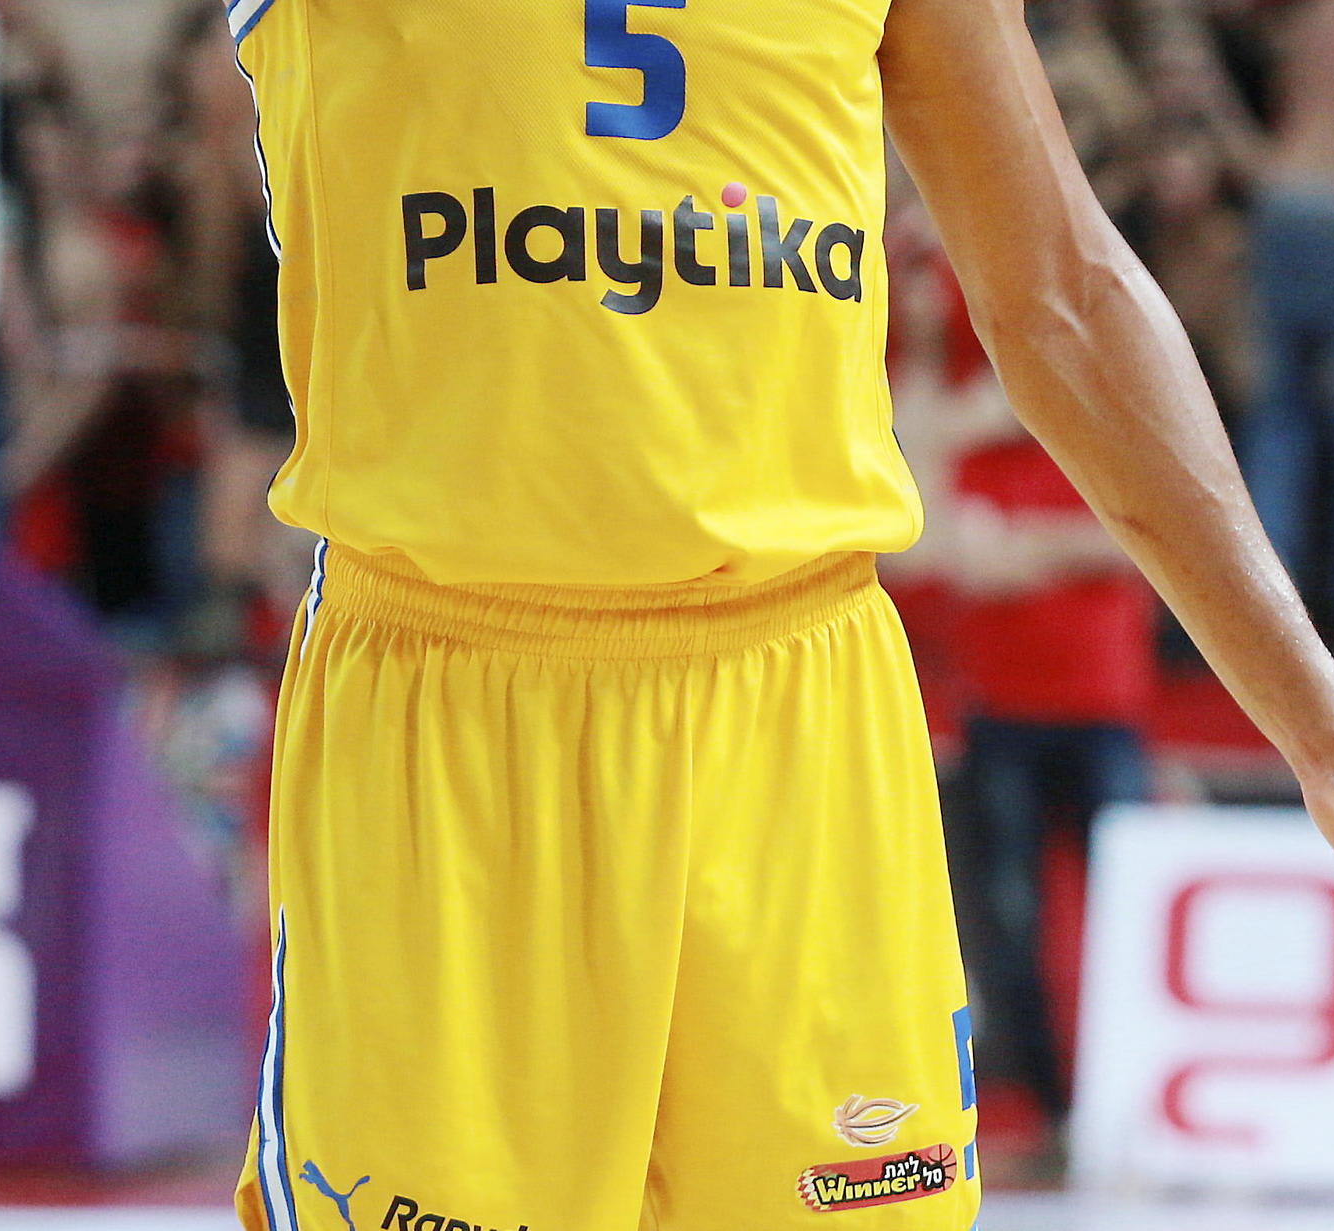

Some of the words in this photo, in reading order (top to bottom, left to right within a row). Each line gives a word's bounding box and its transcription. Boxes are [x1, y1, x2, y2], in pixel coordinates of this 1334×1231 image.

[402, 180, 866, 316] Playtika
[815, 1173, 921, 1203] Winner
[923, 1166, 943, 1187] סל
[884, 1155, 920, 1180] ליגת
